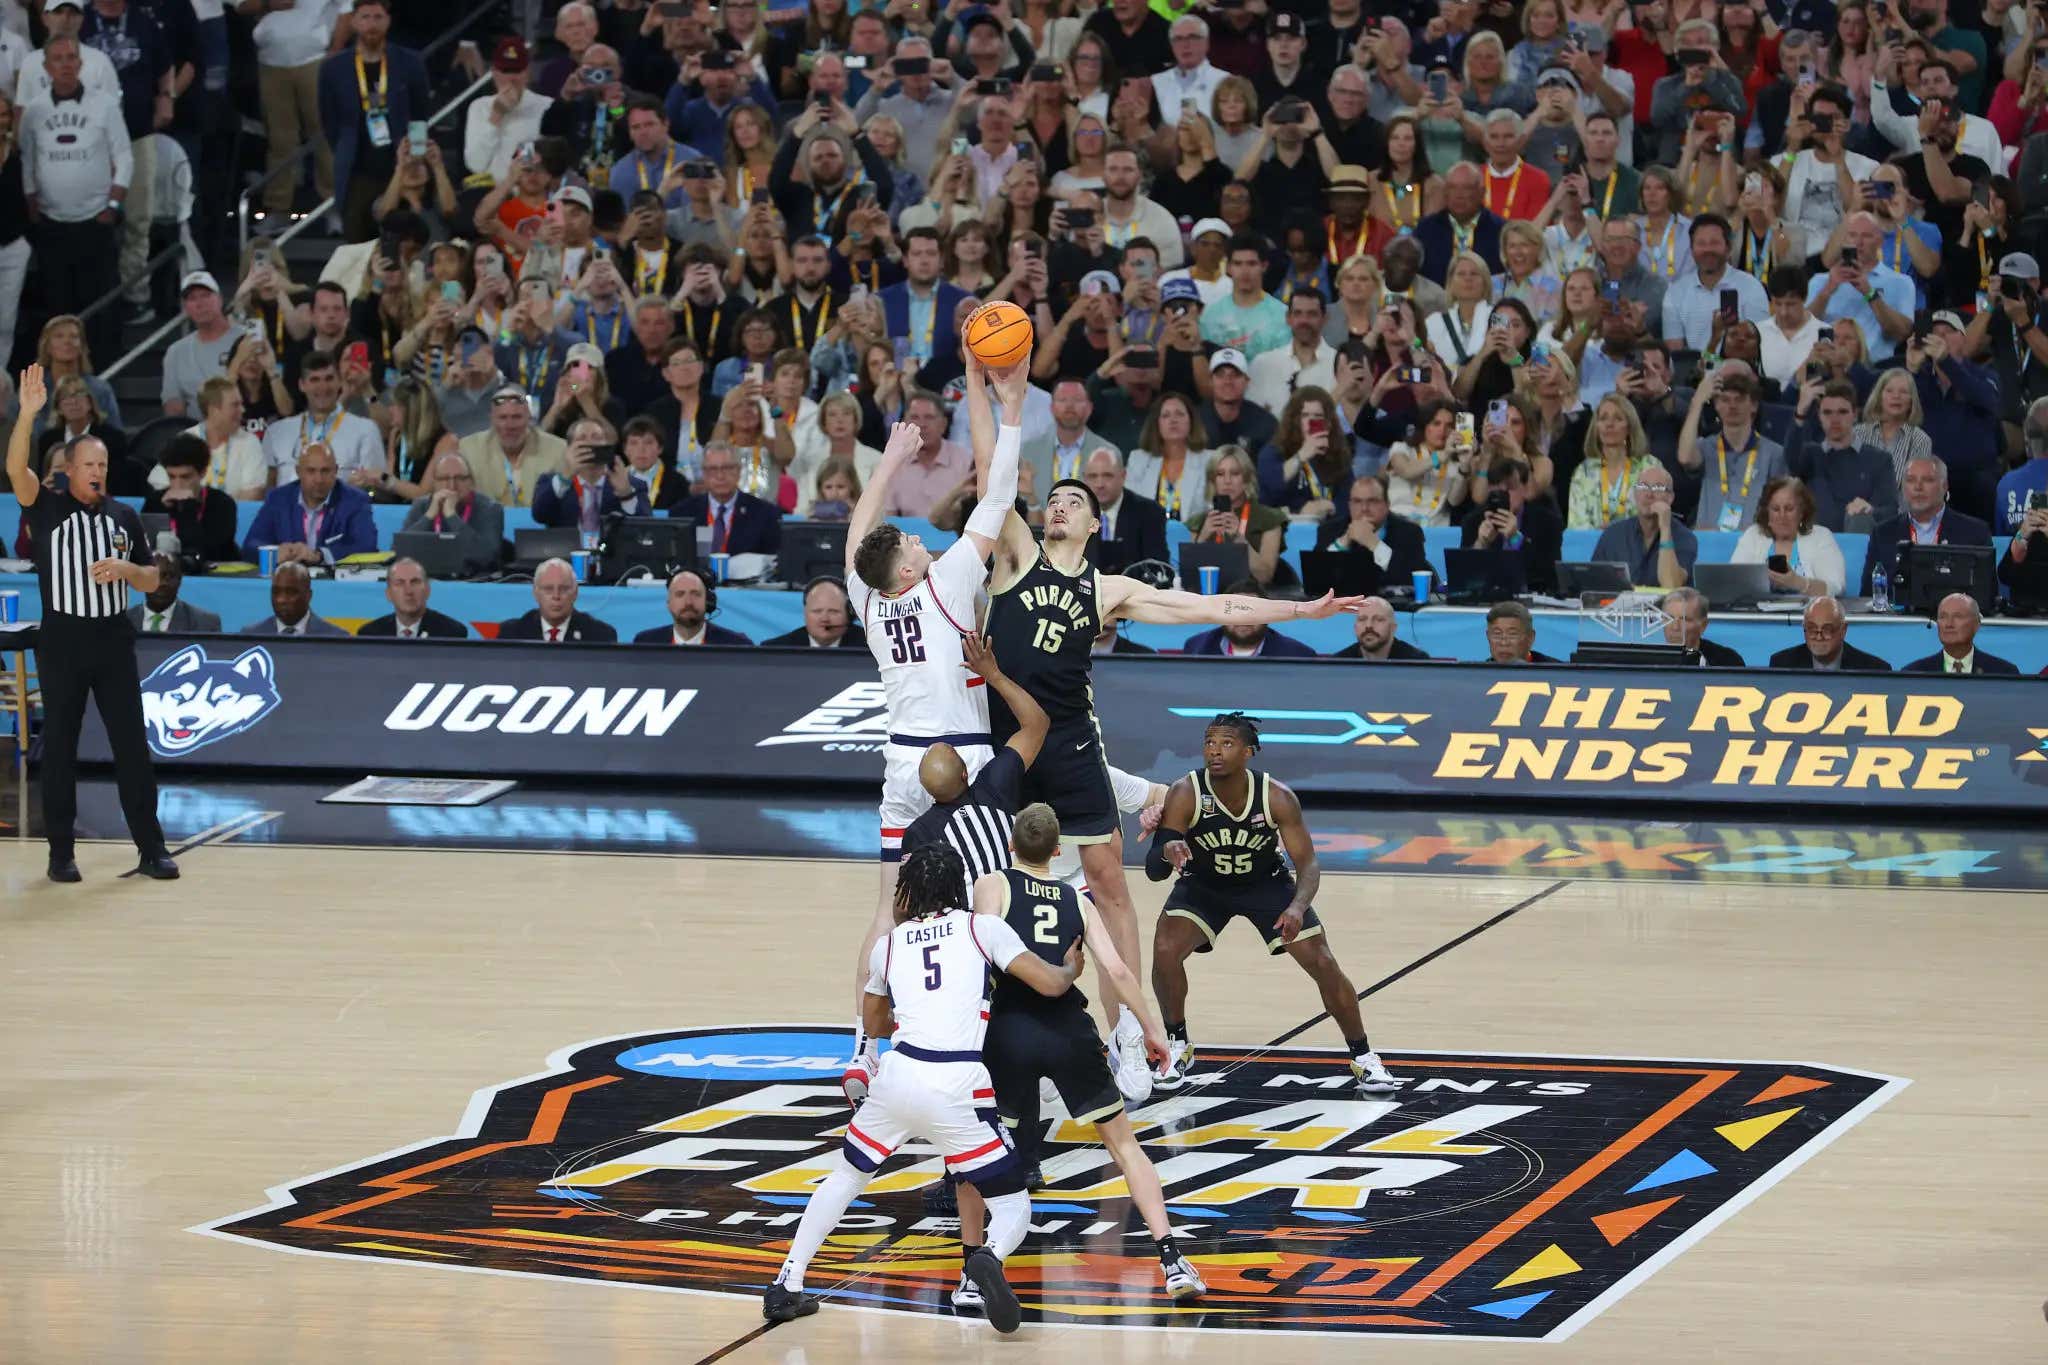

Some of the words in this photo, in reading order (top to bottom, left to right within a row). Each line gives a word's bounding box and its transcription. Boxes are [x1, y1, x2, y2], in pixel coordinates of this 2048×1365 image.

[878, 596, 923, 618] CLINGAN
[1019, 585, 1091, 631] PURDUE
[884, 615, 927, 664] 32
[1032, 618, 1067, 653] 15
[384, 683, 698, 736] UCONN
[1486, 681, 1671, 730] THE
[1688, 686, 1965, 737] ROAD
[1432, 732, 1692, 783] ENDS
[1214, 853, 1253, 875] 55
[1703, 845, 2001, 878] 24
[1024, 879, 1061, 901] LOYER
[906, 922, 953, 944] CASTLE
[1033, 904, 1059, 944] 2
[922, 944, 942, 991] 5
